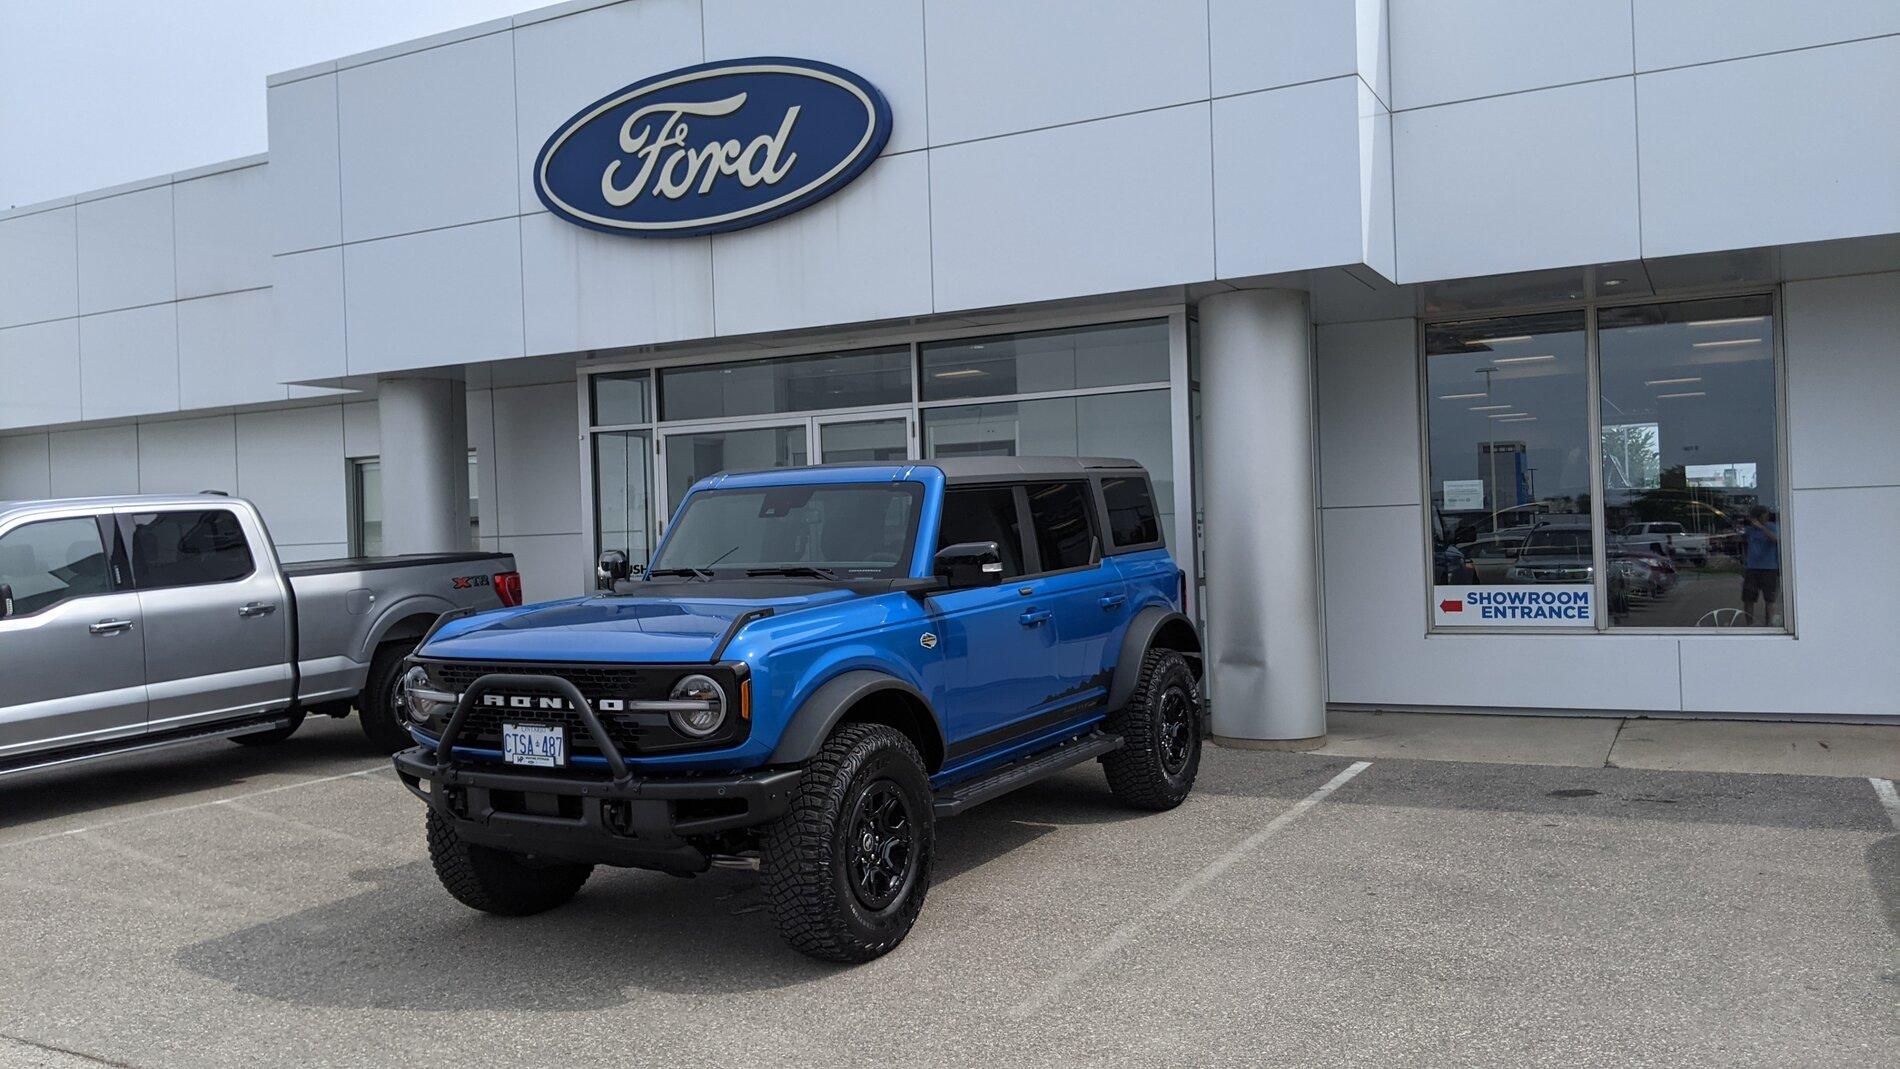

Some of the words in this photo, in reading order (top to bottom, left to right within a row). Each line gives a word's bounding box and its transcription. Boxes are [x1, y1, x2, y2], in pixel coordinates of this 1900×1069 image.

[601, 91, 801, 207] Ford
[1466, 591, 1589, 605] SHOWROOM
[1481, 606, 1589, 619] ENTRANCE
[504, 733, 534, 755] CTSA
[541, 735, 563, 757] 487
